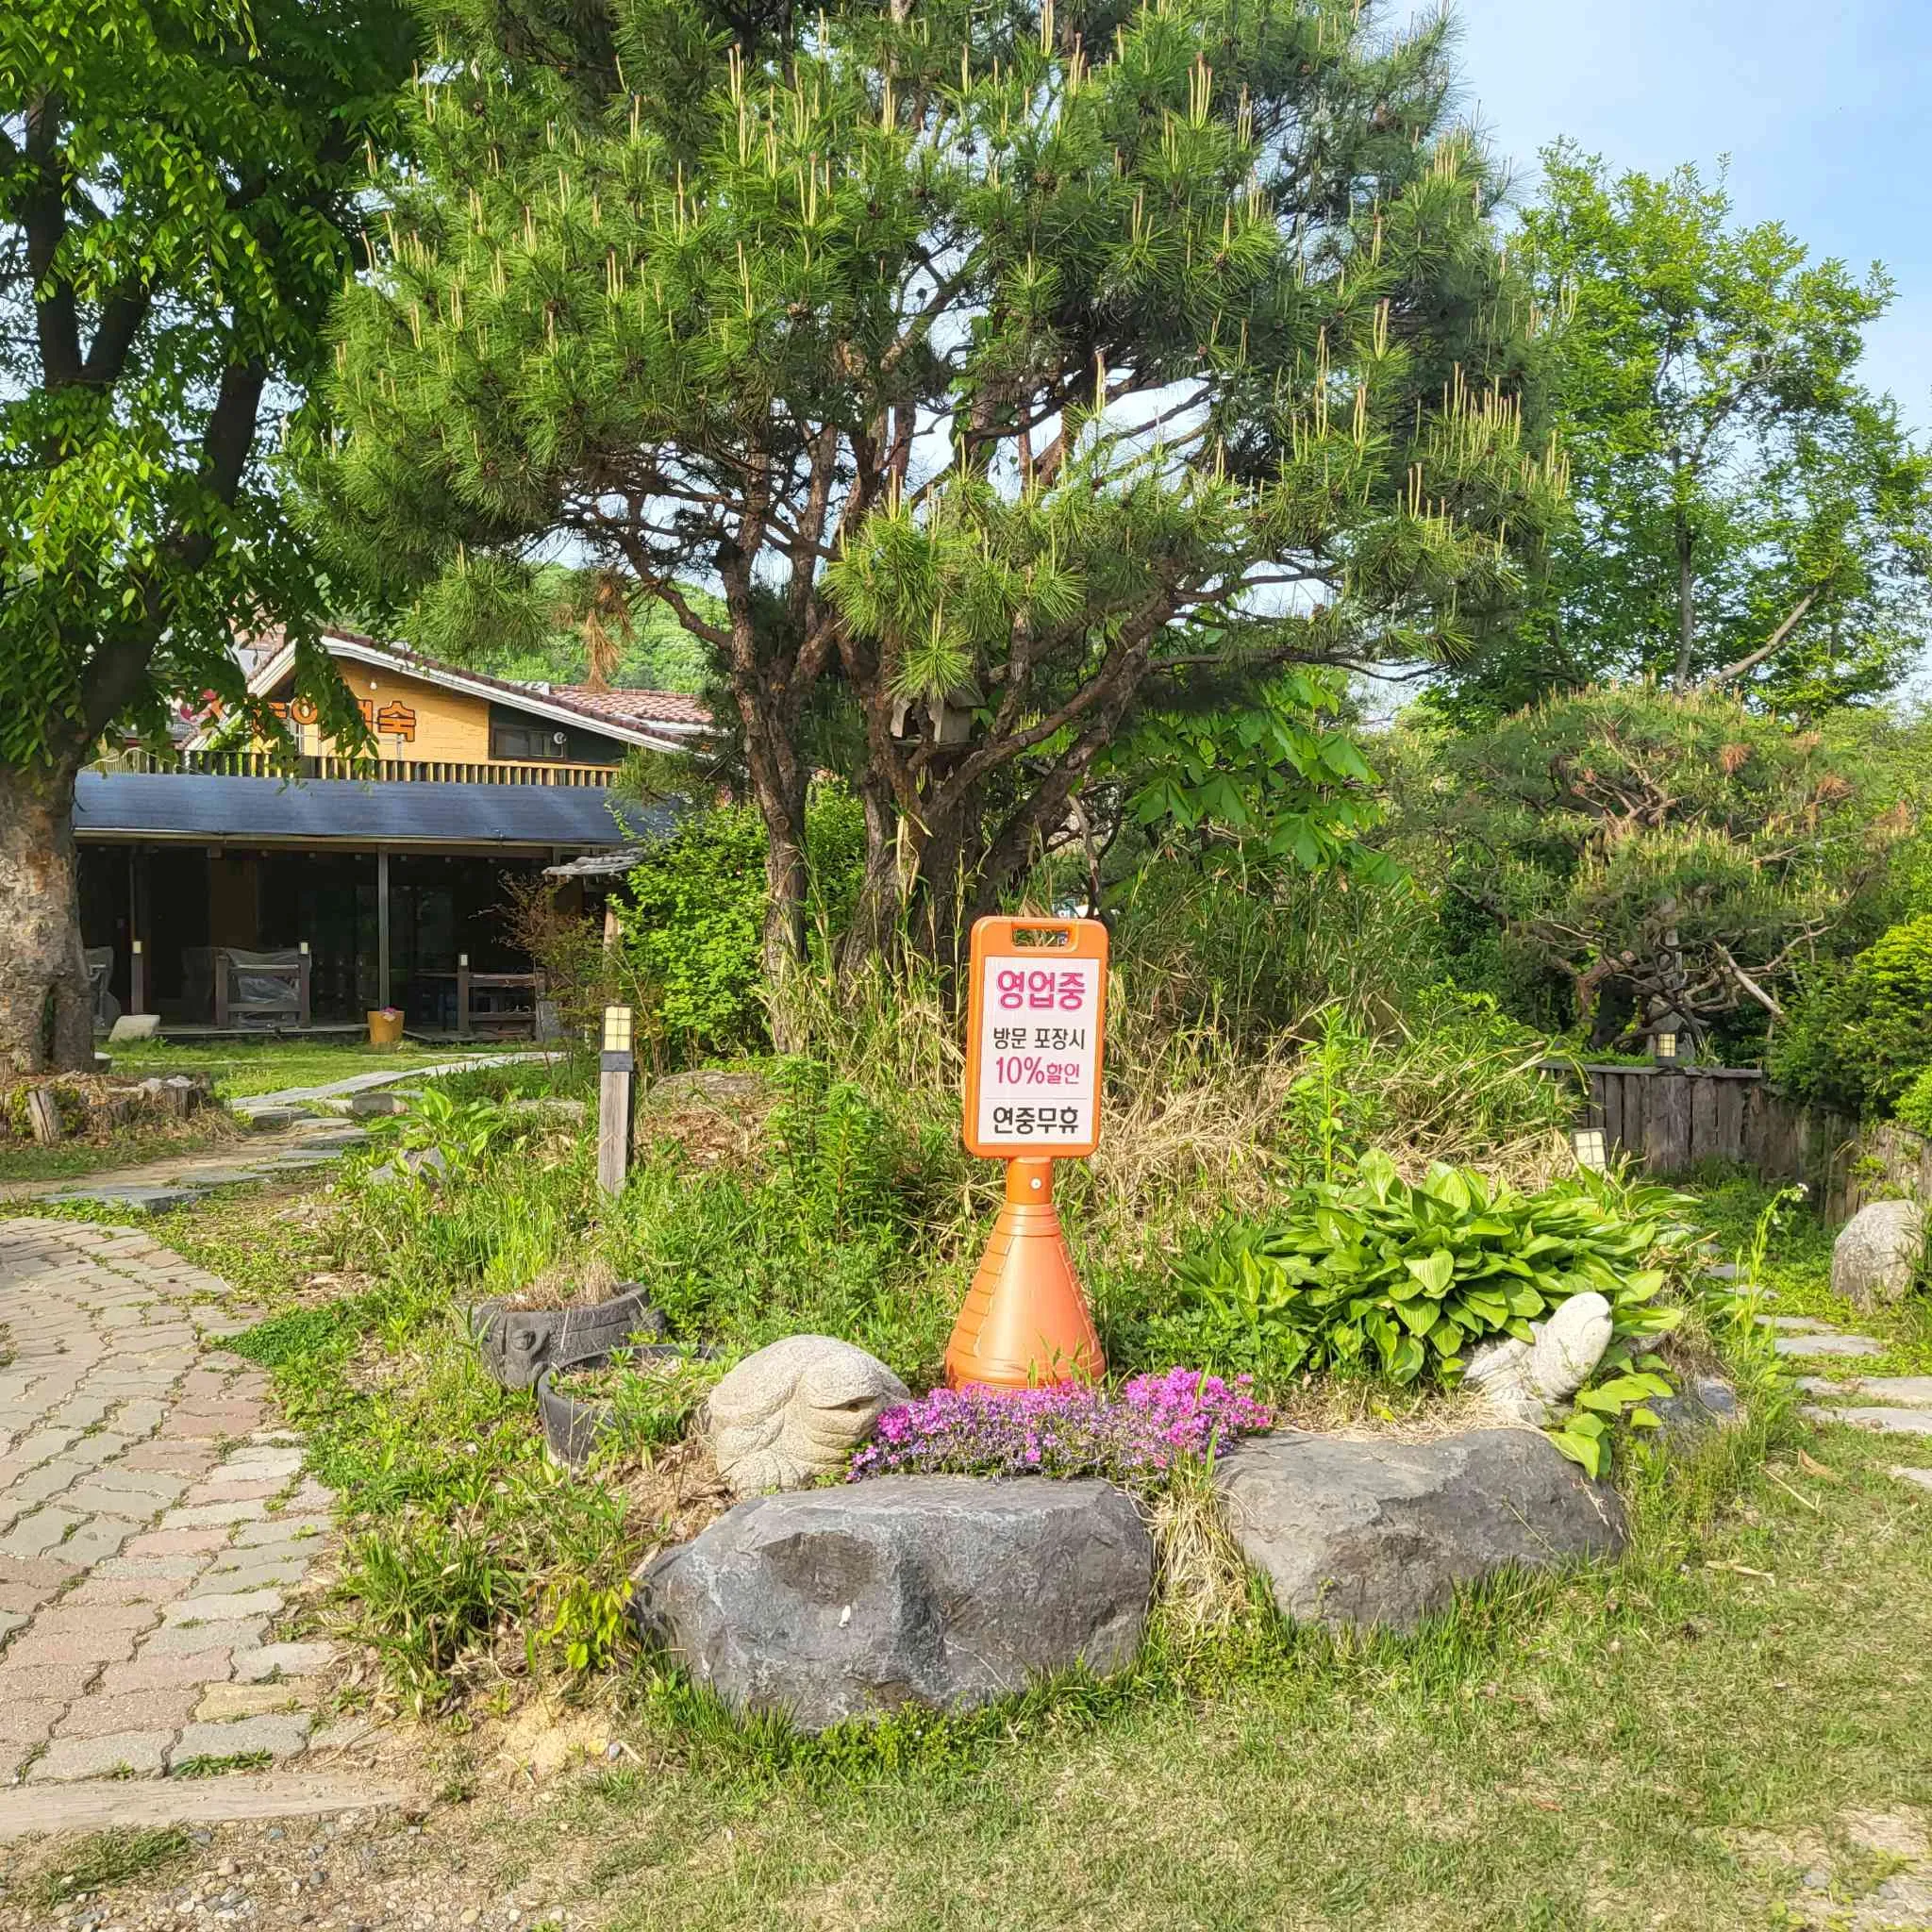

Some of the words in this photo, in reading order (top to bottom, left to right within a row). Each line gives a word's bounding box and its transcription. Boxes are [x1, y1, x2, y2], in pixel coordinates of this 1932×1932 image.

[996, 970, 1086, 1011] 영업중
[993, 1027, 1027, 1050] 방문
[1034, 1027, 1085, 1050] 포장시
[995, 1056, 1080, 1085] 10%할인
[992, 1106, 1079, 1135] 연중무휴
